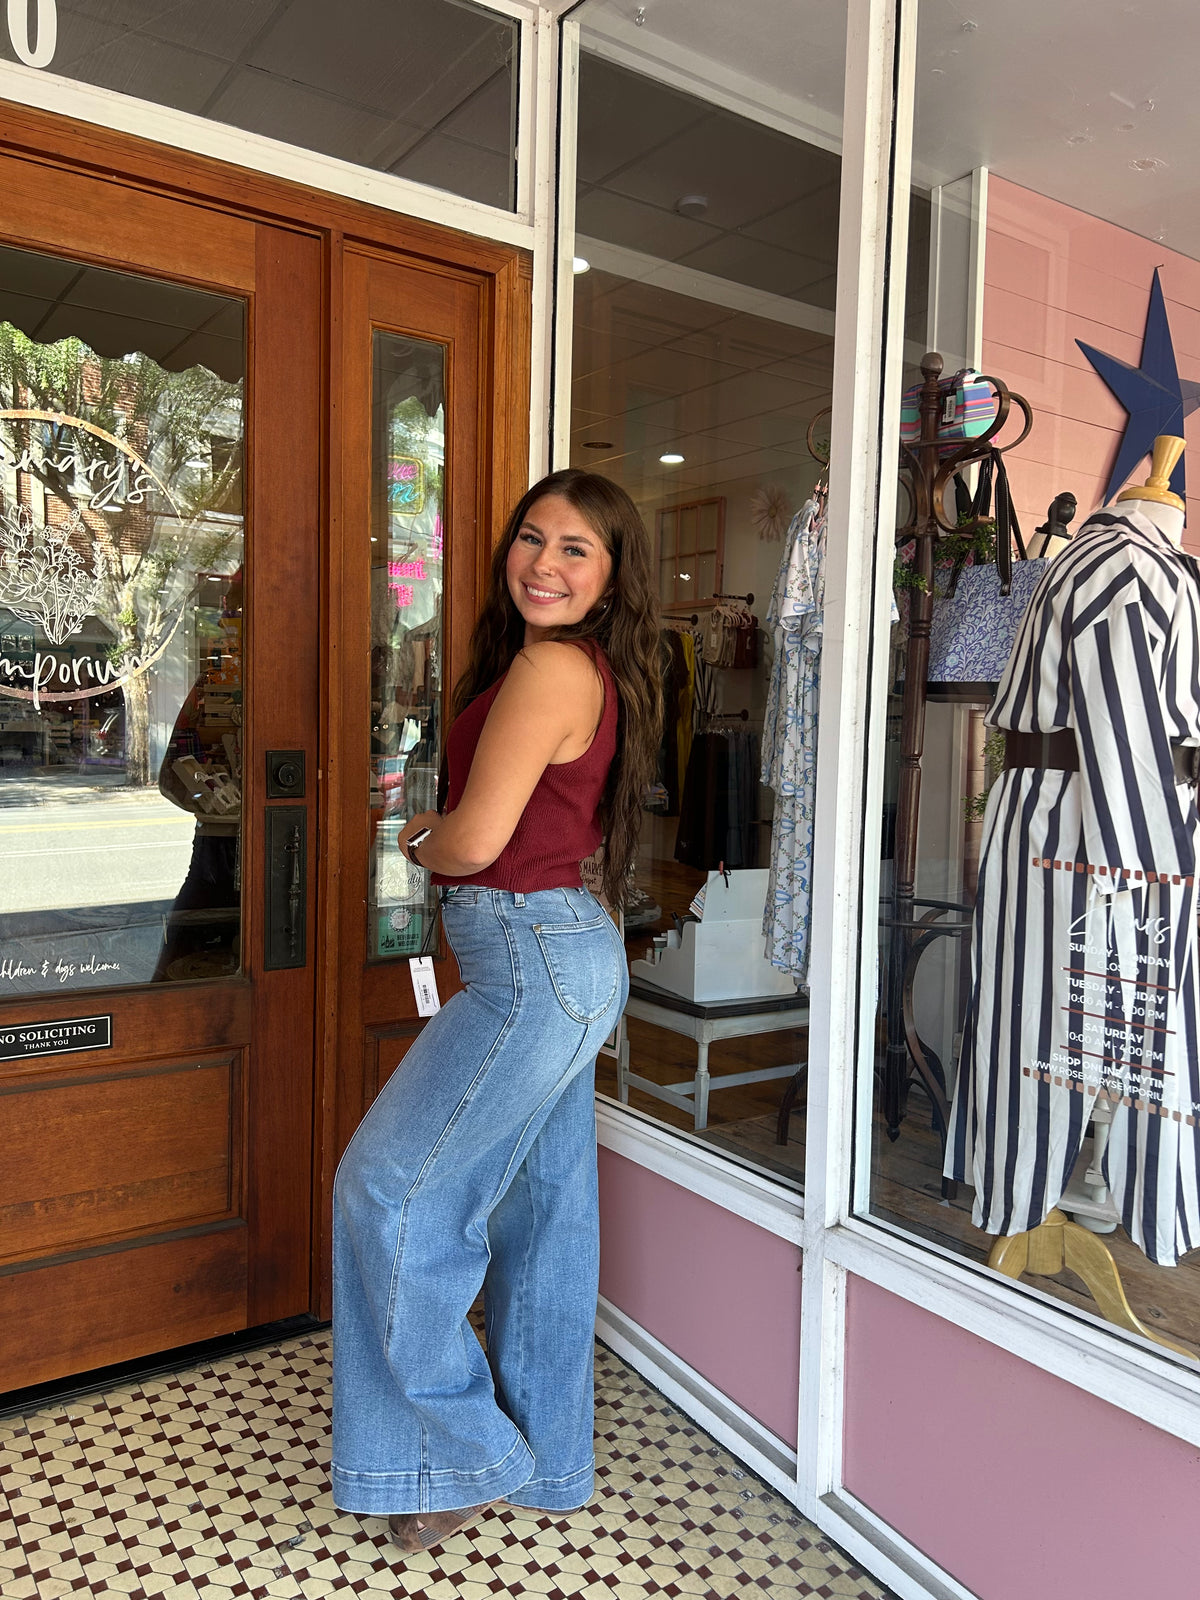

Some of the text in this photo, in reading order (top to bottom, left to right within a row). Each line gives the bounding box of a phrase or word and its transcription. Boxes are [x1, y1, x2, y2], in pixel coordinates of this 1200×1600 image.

[1069, 942, 1114, 958] SUNDAY
[1121, 951, 1171, 968] ONDAY
[0, 959, 37, 979] hildren
[41, 960, 50, 978] &
[55, 958, 76, 982] dogs
[1097, 961, 1140, 975] CLOSD
[1066, 977, 1115, 995] TUESDAY
[1122, 989, 1165, 1005] IDAY
[1067, 993, 1094, 1006] 10:00
[1095, 1000, 1113, 1010] AM
[1121, 1004, 1145, 1017] 600
[1147, 1009, 1166, 1021] PM
[19, 1024, 96, 1043] SOLICITING
[24, 1041, 51, 1050] THANK
[1084, 1022, 1144, 1044] SATURDAY
[1065, 1030, 1092, 1044] 10:00
[1094, 1039, 1111, 1050] AM
[1145, 1050, 1163, 1062] PM
[1052, 1052, 1170, 1090] SHOP ONLINE ANYTIM
